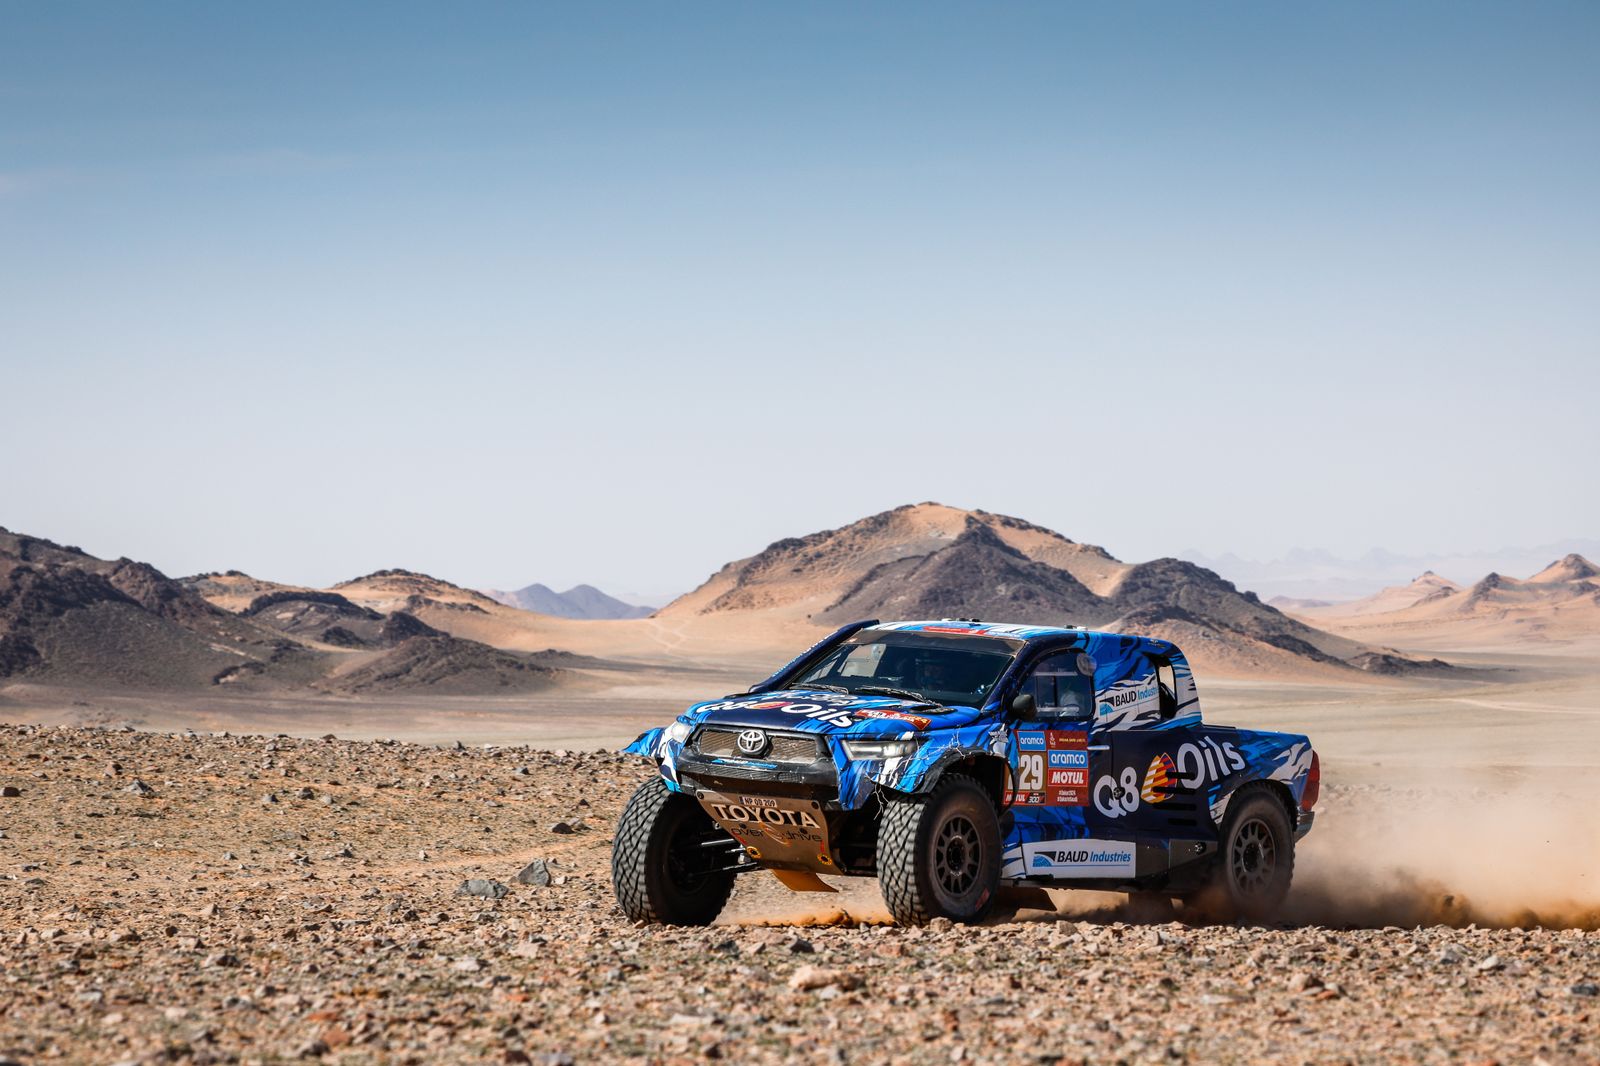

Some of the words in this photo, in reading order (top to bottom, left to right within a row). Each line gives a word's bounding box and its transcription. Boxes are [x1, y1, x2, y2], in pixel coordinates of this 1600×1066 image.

[1115, 691, 1137, 707] BAUD
[781, 703, 853, 728] Oils
[1020, 737, 1044, 745] aramco
[1050, 753, 1086, 764] aramco
[1051, 771, 1084, 784] MOTUL
[1093, 766, 1140, 818] Q8
[1176, 735, 1246, 790] Oils
[710, 803, 821, 829] TOYOTA
[730, 827, 764, 837] over
[1057, 851, 1088, 863] BAUD
[1089, 850, 1131, 863] Industries
